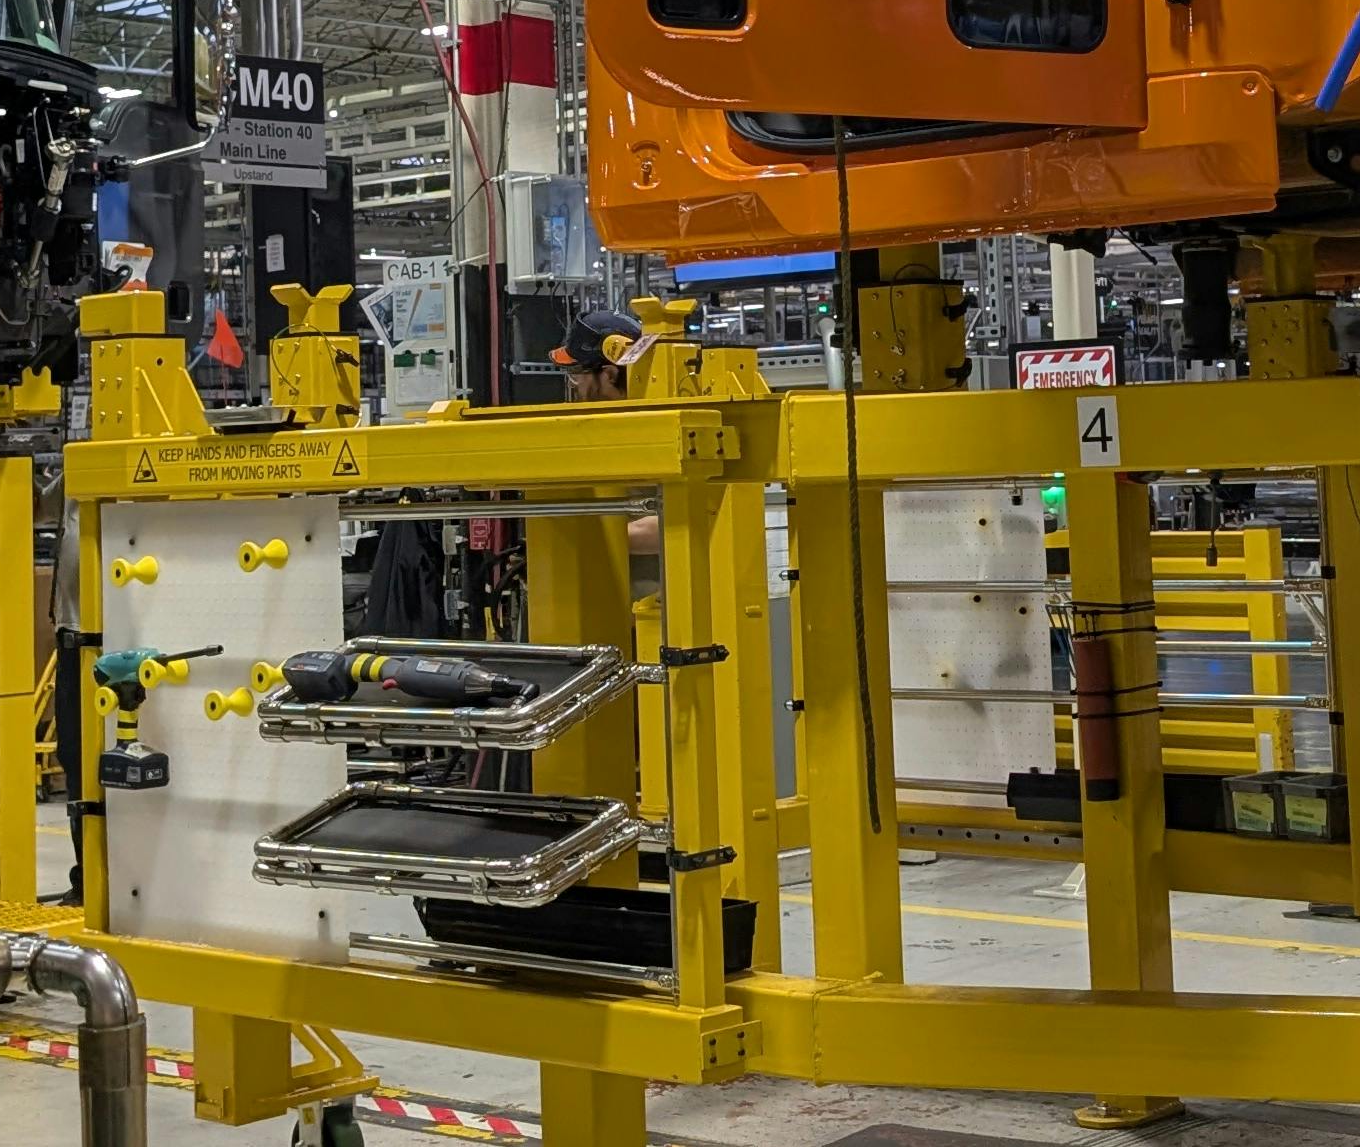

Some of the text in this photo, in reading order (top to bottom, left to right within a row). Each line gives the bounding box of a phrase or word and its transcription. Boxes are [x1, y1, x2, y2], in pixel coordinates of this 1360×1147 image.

[244, 121, 293, 139] Station
[296, 124, 313, 141] 40
[220, 142, 287, 160] Main Line
[233, 168, 274, 182] Upstand
[387, 261, 437, 281] CAB-1
[1032, 369, 1097, 389] EMERGENCY
[1082, 407, 1113, 452] 4
[158, 442, 332, 462] KEEP HANDS AND FINGERS AWAY
[189, 463, 302, 482] FROM MOVING PARTS
